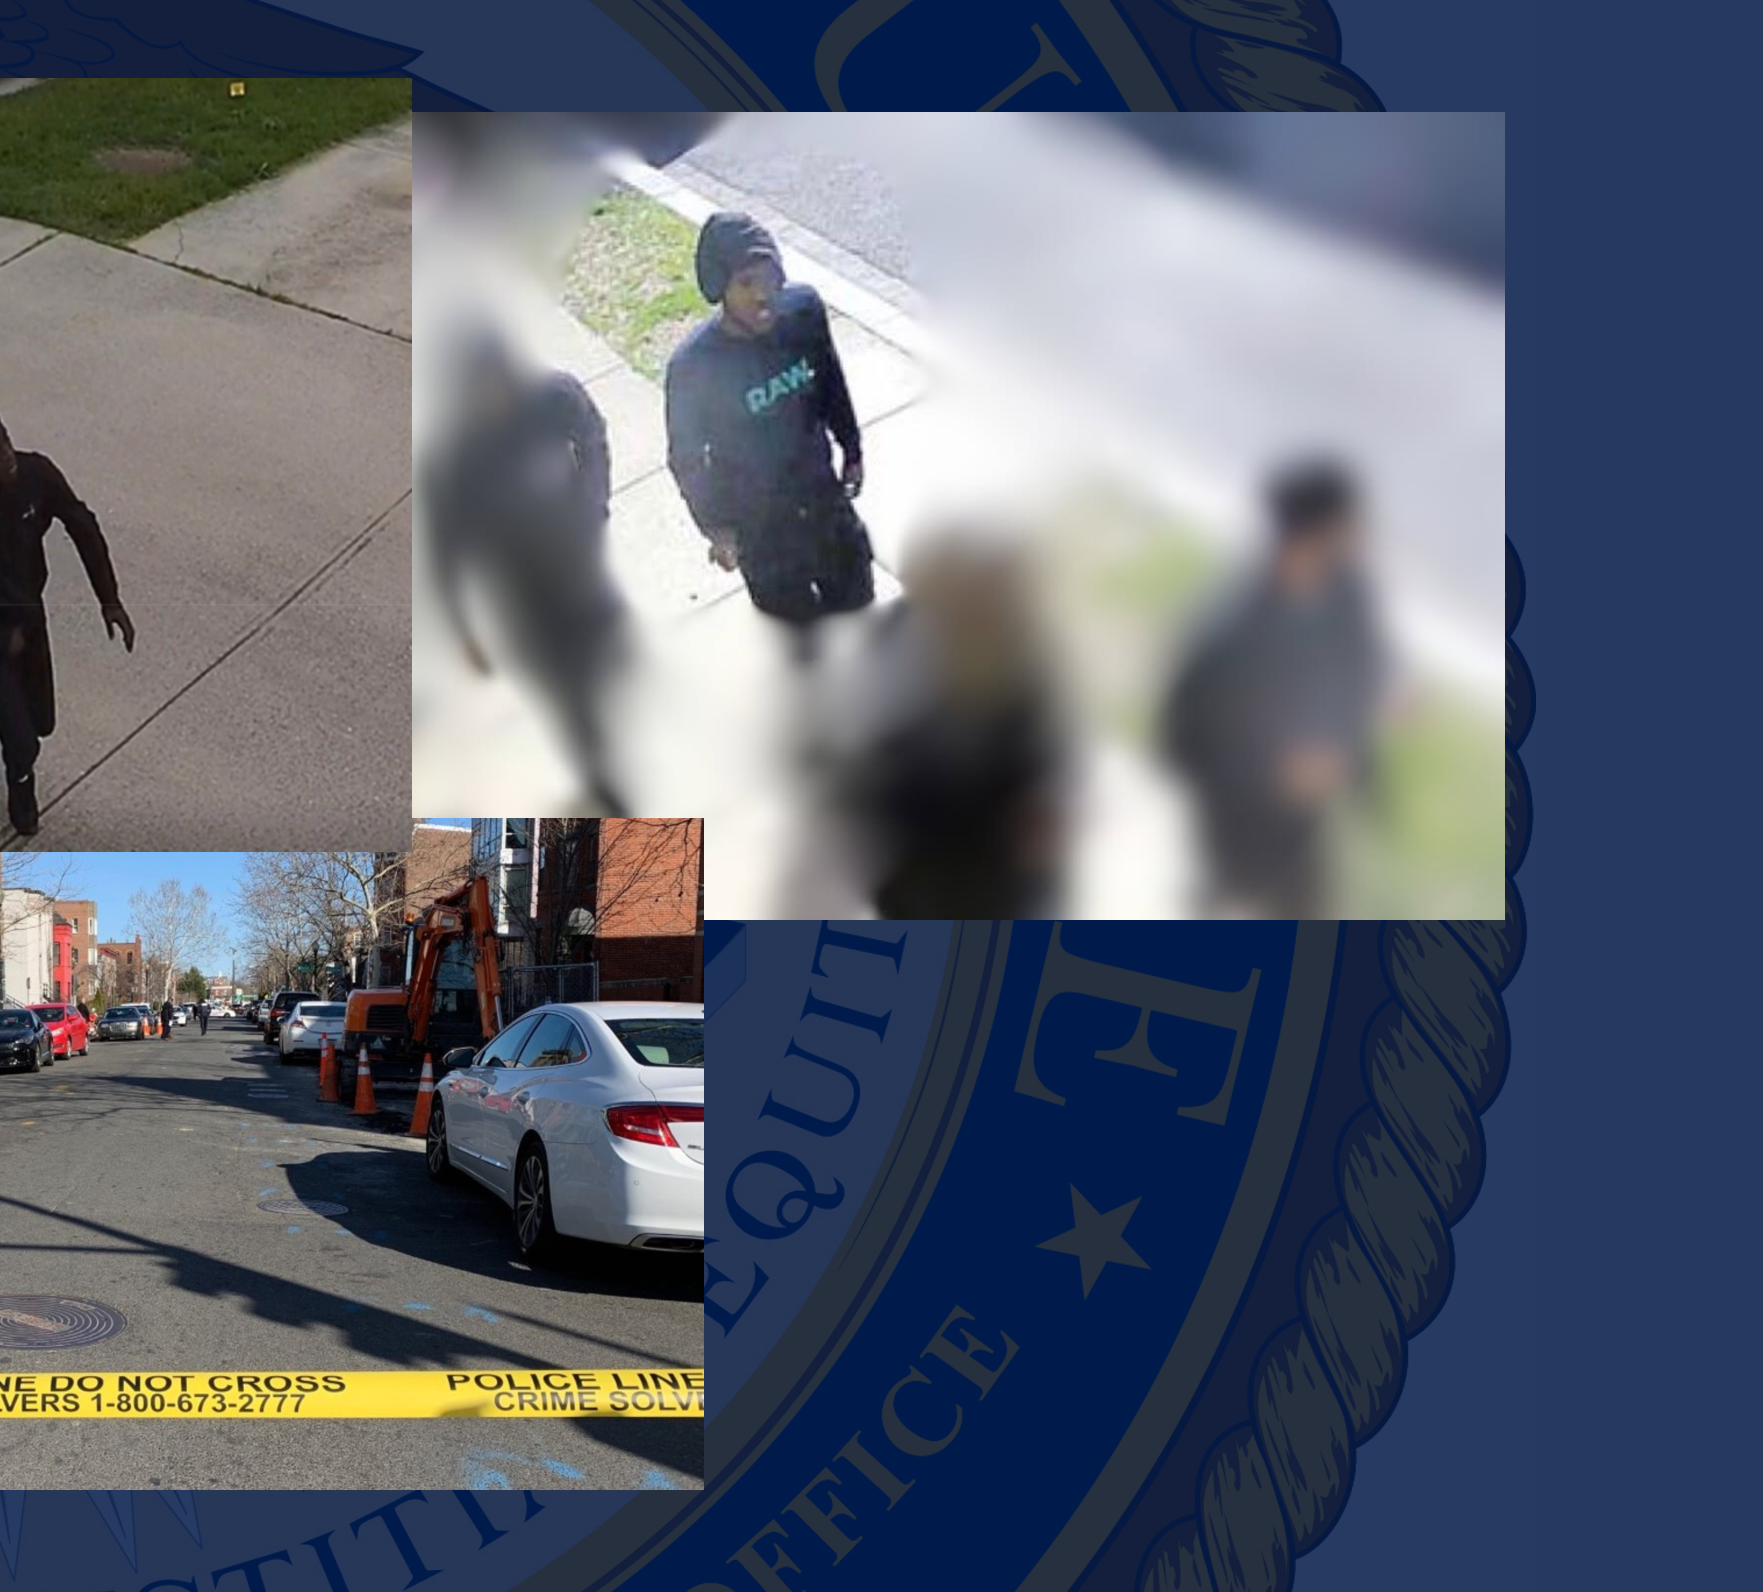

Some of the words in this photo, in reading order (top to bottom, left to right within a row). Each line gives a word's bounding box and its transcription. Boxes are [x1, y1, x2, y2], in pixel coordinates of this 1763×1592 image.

[48, 1376, 103, 1393] DO
[117, 1375, 196, 1393] NOT
[207, 1375, 347, 1393] CROSS
[446, 1373, 601, 1390] POLICE
[612, 1373, 704, 1390] LINE
[93, 1393, 307, 1413] 1-800-673-2777
[494, 1391, 599, 1412] CRIME
